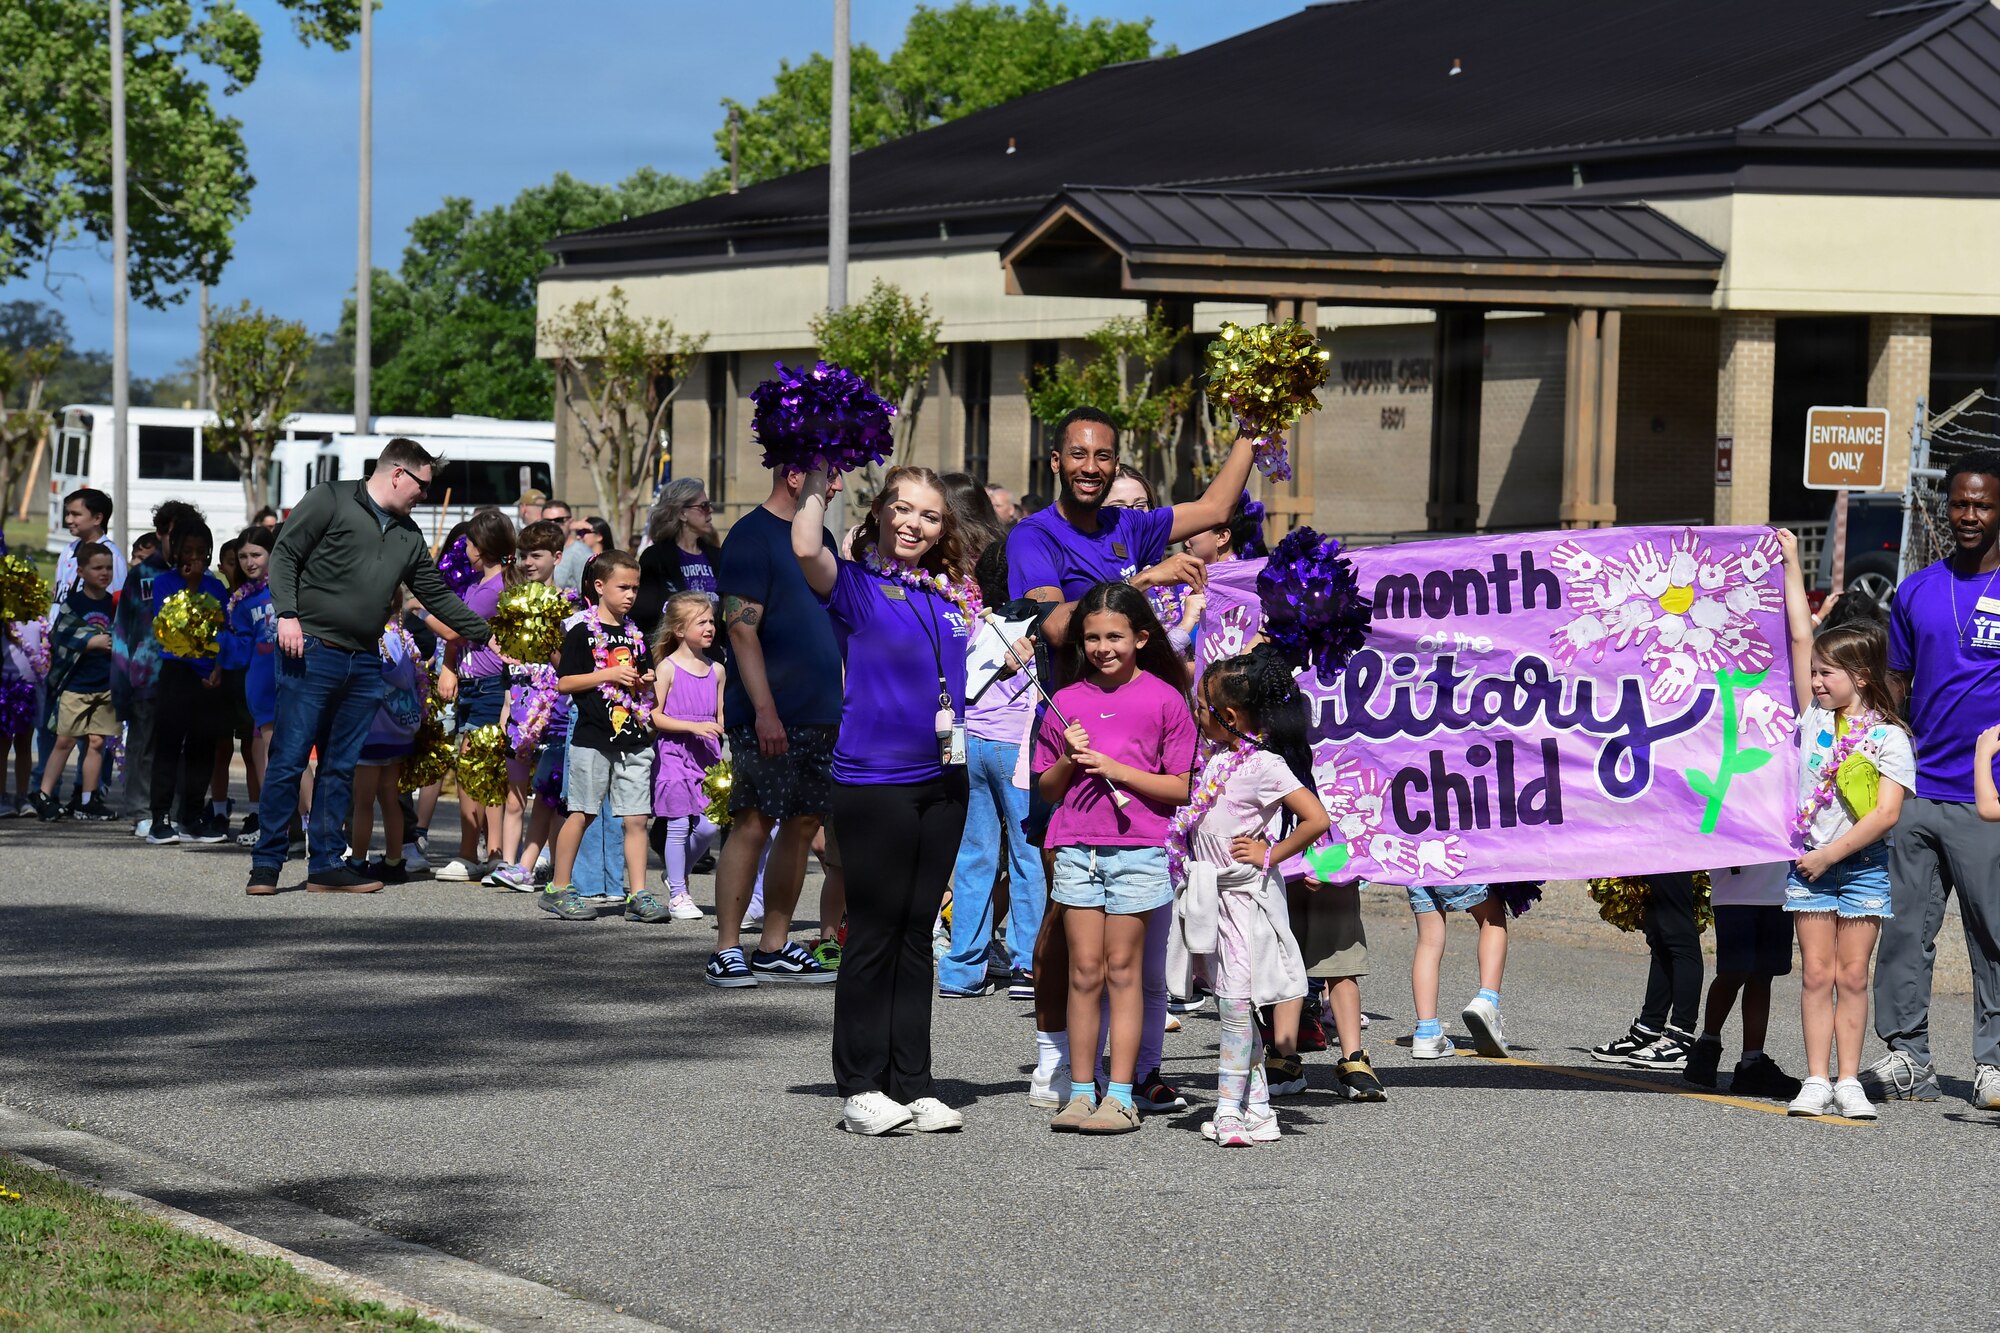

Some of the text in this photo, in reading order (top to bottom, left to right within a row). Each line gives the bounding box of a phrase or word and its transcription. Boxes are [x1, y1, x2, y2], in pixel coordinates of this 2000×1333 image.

[1340, 359, 1393, 392] YOUTH
[1812, 425, 1883, 445] ENTRANCE
[1828, 451, 1864, 470] ONLY
[1373, 551, 1561, 619] month
[587, 635, 617, 646] PIZA
[1416, 631, 1494, 654] of the
[400, 710, 420, 725] 626
[1303, 646, 1719, 804] ilitary
[1391, 737, 1564, 835] child
